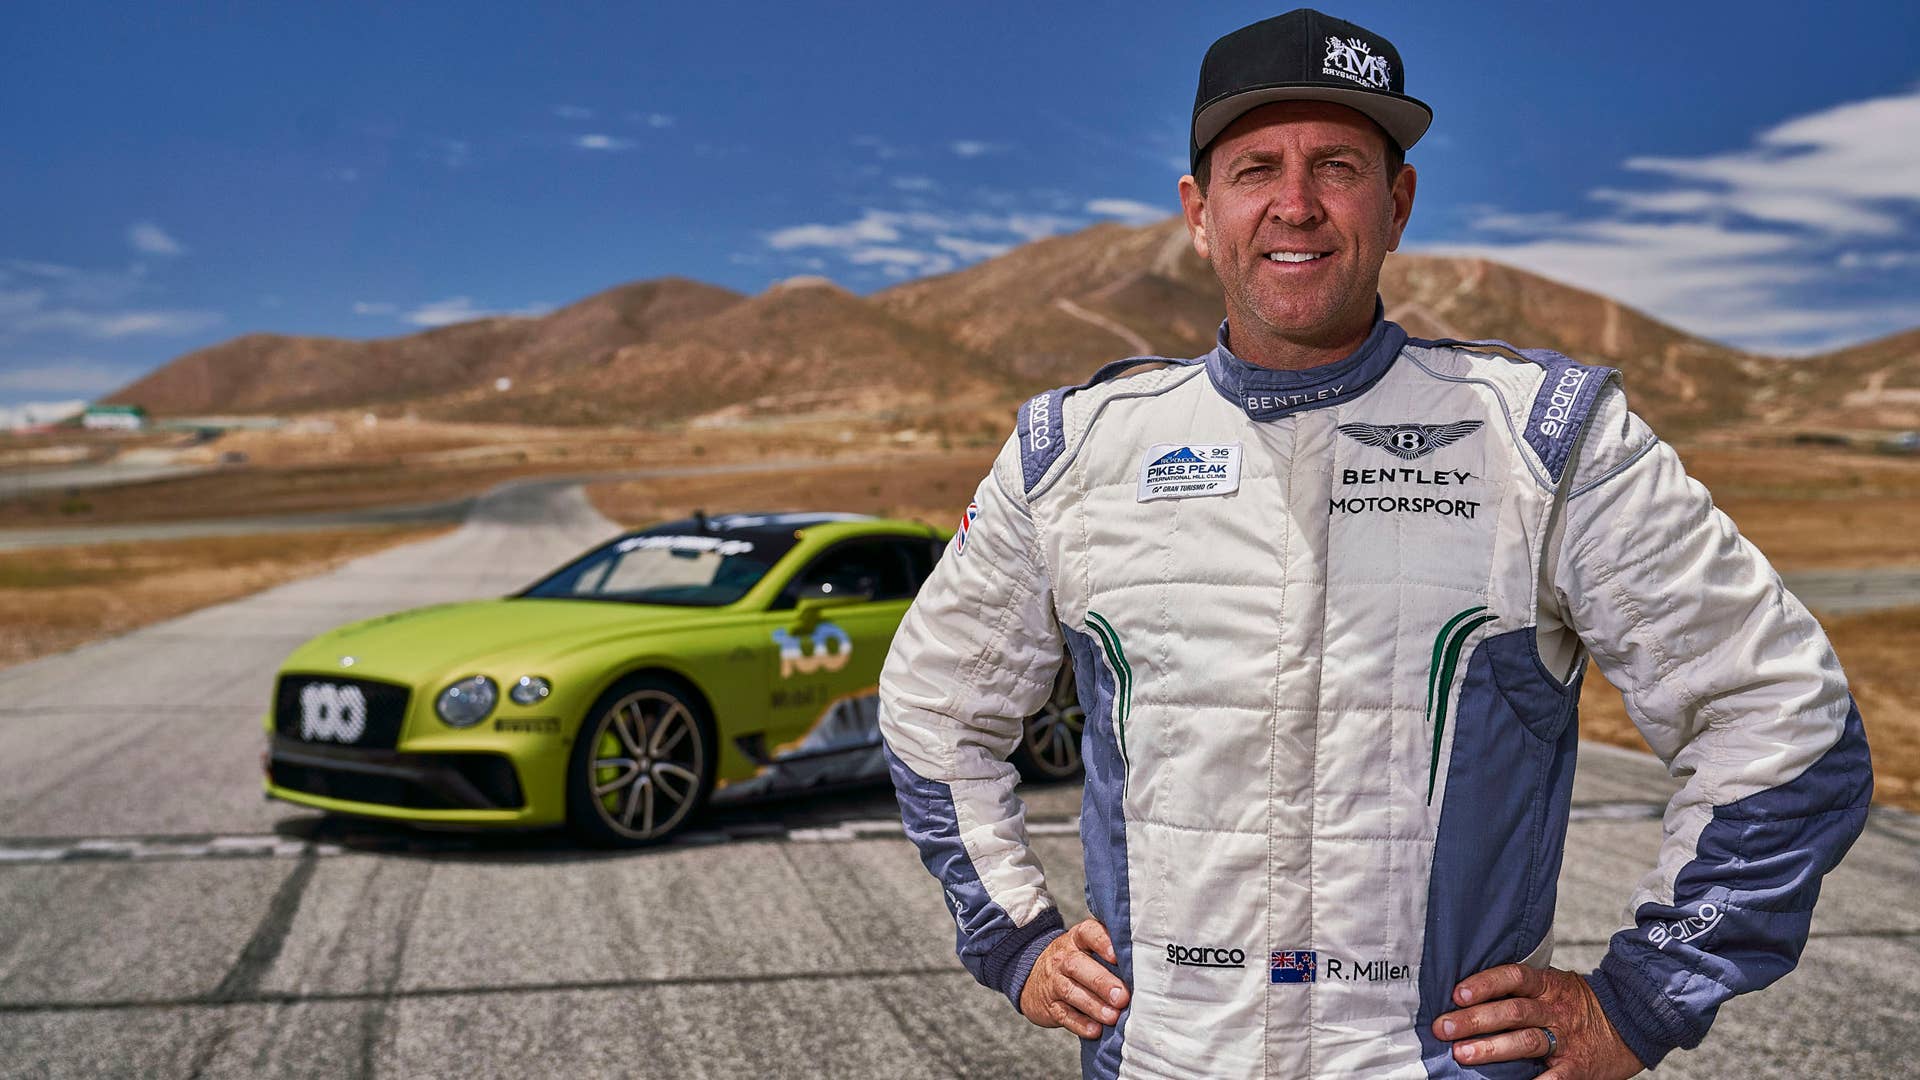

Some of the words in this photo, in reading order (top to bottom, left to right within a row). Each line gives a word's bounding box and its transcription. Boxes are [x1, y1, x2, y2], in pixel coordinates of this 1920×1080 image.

[1248, 385, 1343, 410] BENTLEY
[1540, 368, 1586, 438] sparco
[1211, 448, 1229, 456] 96
[1398, 433, 1420, 450] B
[1147, 465, 1185, 478] PIKES
[1189, 464, 1227, 474] PEAK
[1147, 475, 1191, 484] INTERNATIONAL
[1343, 468, 1470, 485] BENTLEY
[1329, 497, 1480, 519] MOTORSPORT
[300, 682, 367, 743] 100
[1167, 943, 1245, 968] sparco
[1327, 959, 1410, 981] R.Millen
